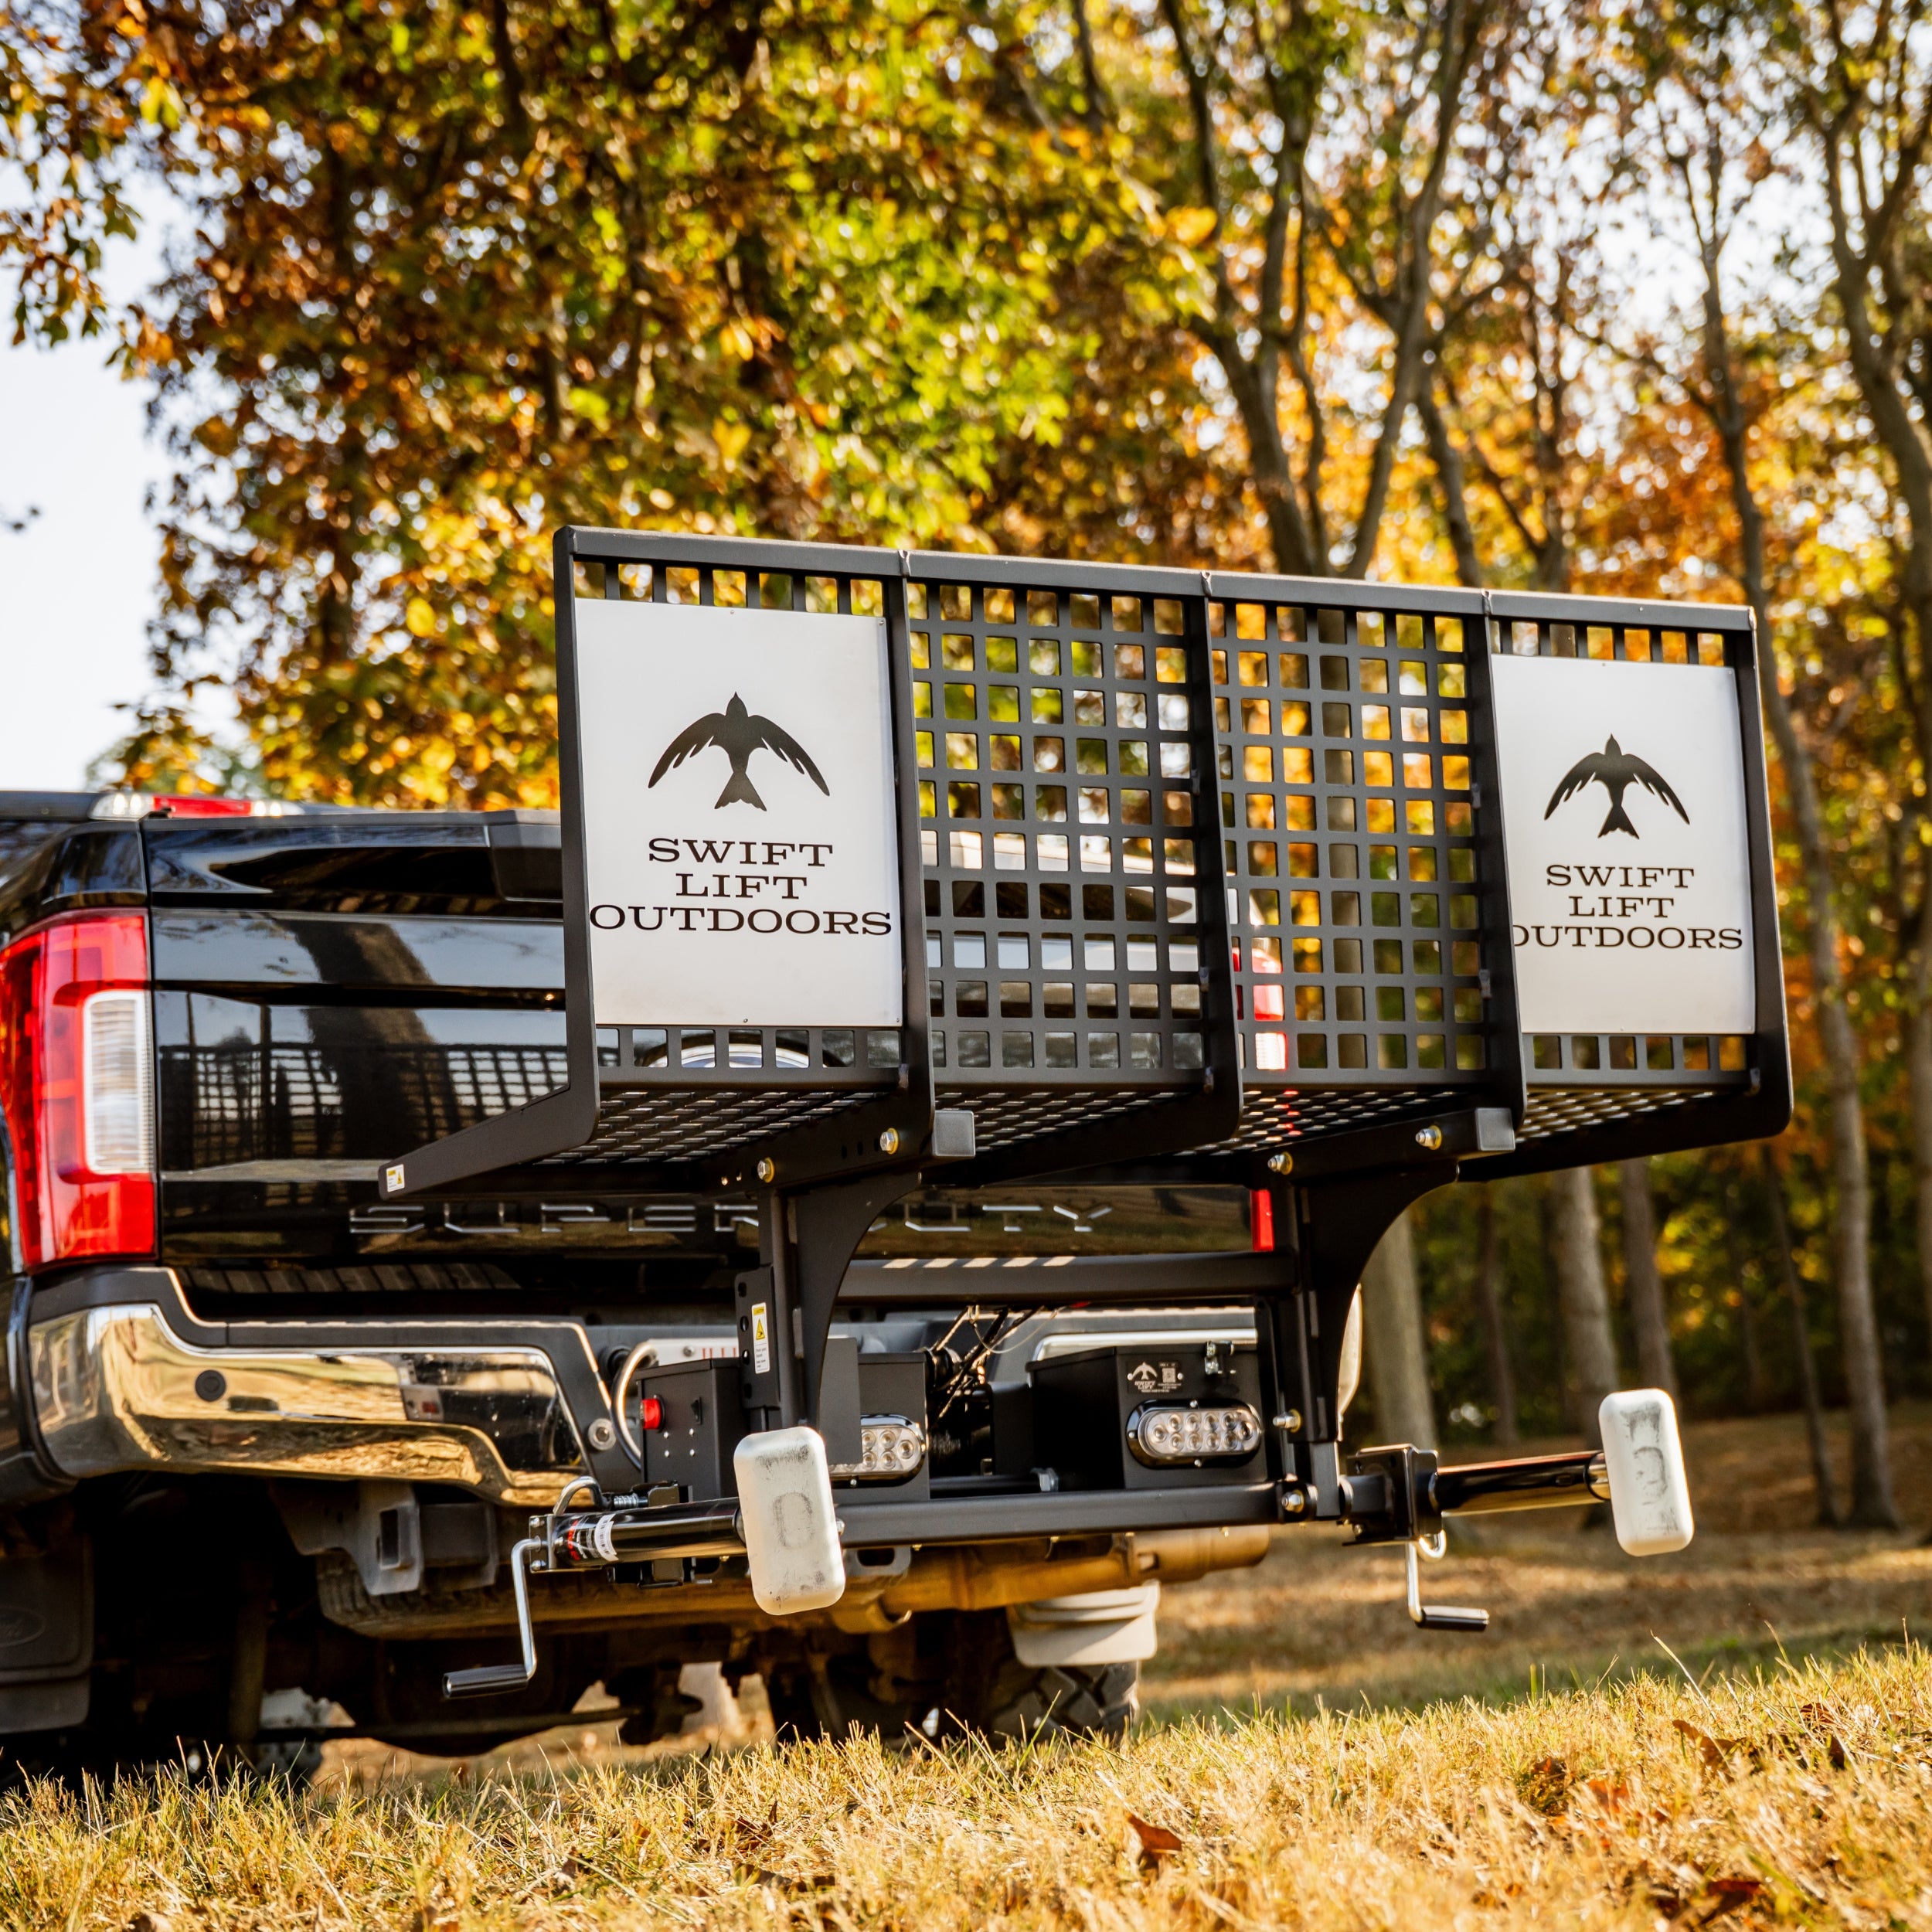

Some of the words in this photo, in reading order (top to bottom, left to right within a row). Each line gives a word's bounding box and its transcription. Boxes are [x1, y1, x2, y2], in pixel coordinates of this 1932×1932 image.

[648, 838, 833, 867] SWIFT
[675, 872, 808, 900] LIFT
[1546, 864, 1695, 889] SWIFT
[589, 904, 892, 936] OUTDOORS
[1568, 896, 1675, 918] LIFT
[349, 1202, 759, 1234] SUPER
[868, 1203, 1112, 1233] UTY
